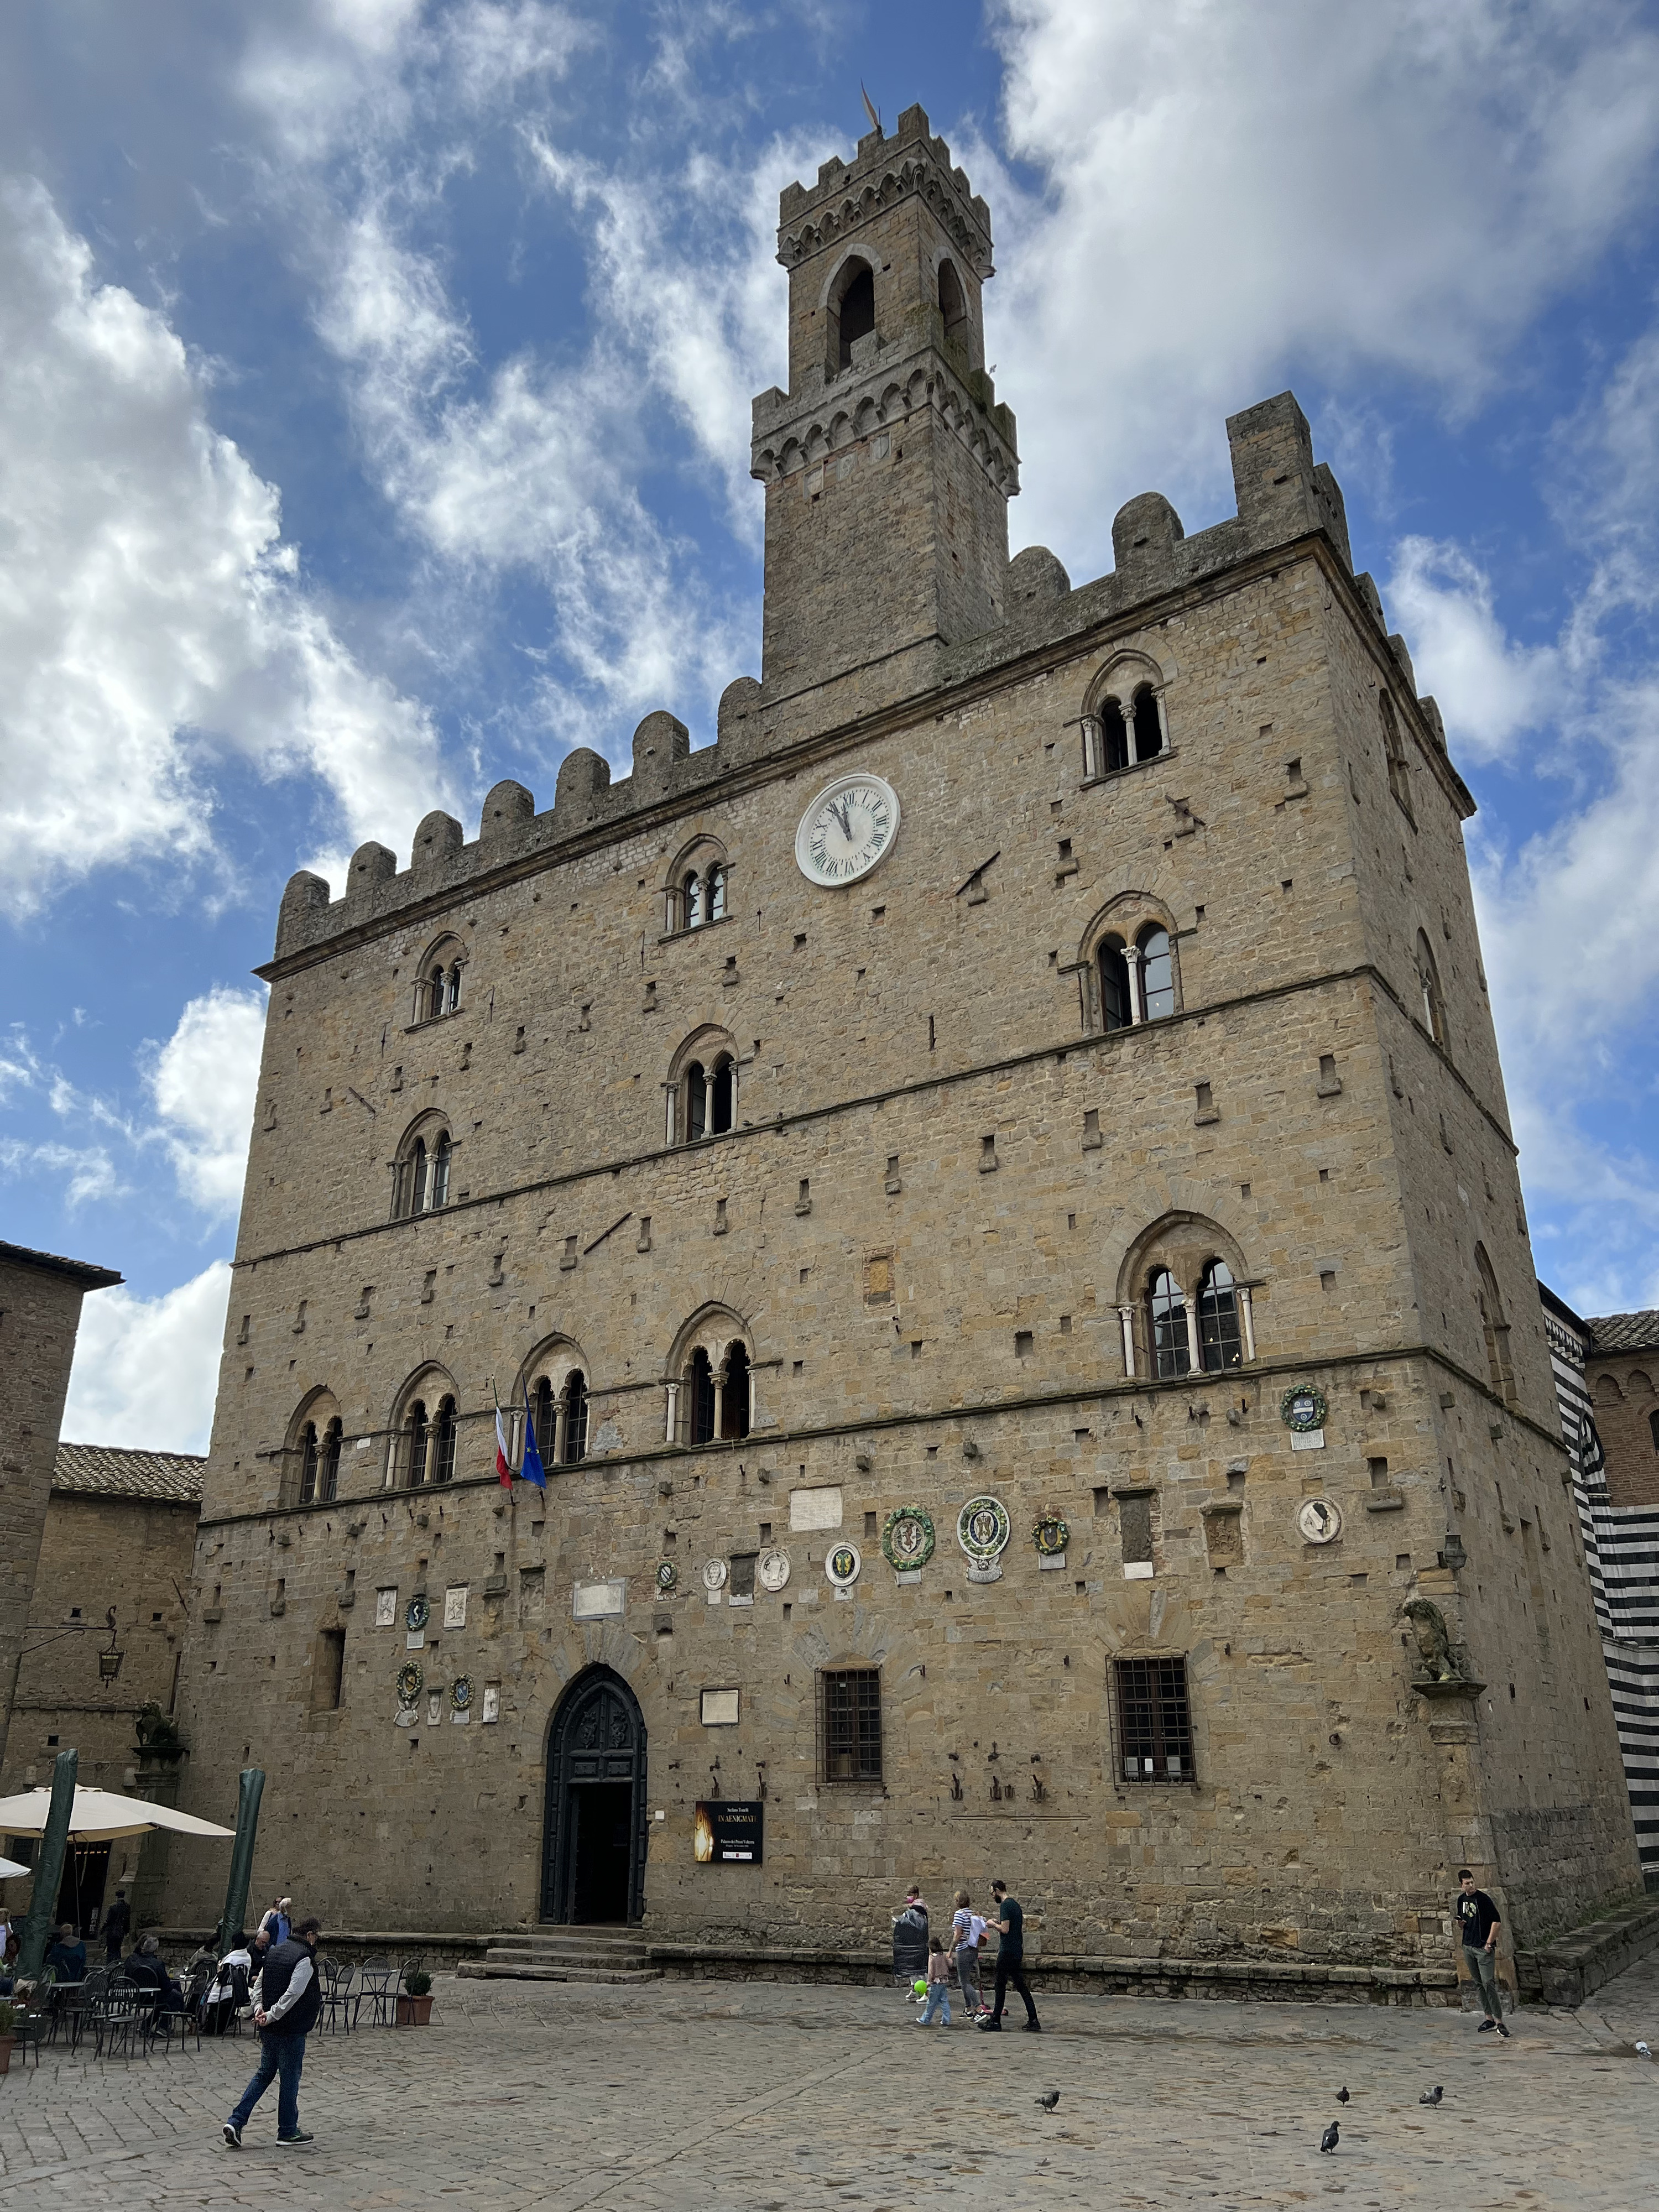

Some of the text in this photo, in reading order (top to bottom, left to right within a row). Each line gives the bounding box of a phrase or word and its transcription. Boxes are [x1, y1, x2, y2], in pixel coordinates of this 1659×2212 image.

[872, 800, 883, 812] II
[816, 822, 828, 831] X
[875, 815, 886, 827] III
[812, 838, 823, 851] IX
[815, 851, 828, 868] VIII
[863, 852, 871, 863] V
[826, 860, 838, 873] VII
[844, 860, 854, 874] VI
